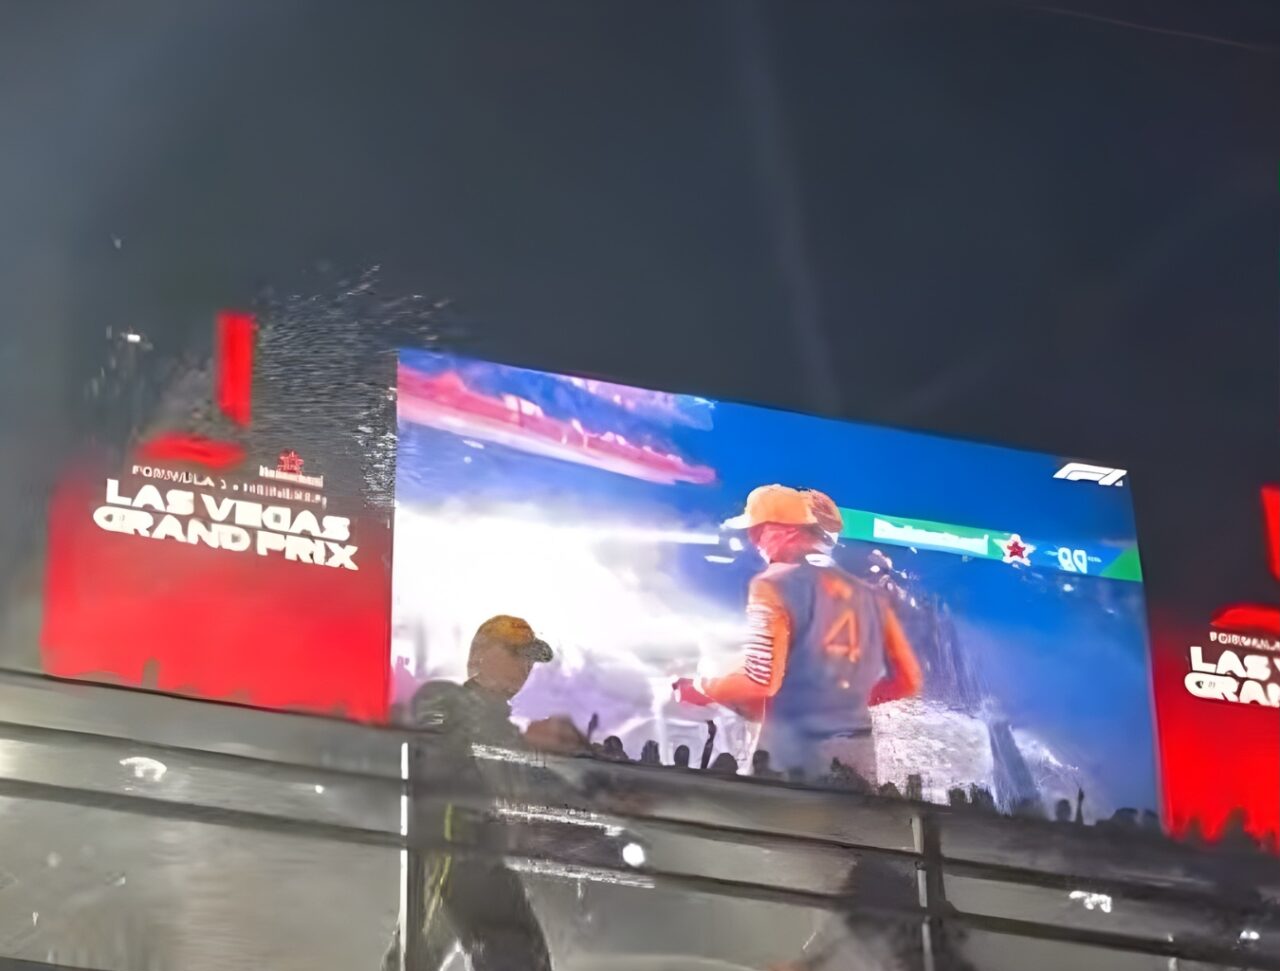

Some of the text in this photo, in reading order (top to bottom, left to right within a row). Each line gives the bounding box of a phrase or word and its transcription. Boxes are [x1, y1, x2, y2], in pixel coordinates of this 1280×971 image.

[93, 505, 359, 571] GRAND PRIX
[106, 478, 194, 516] LAS
[200, 493, 350, 541] VEGAS
[1190, 646, 1270, 681] LAS
